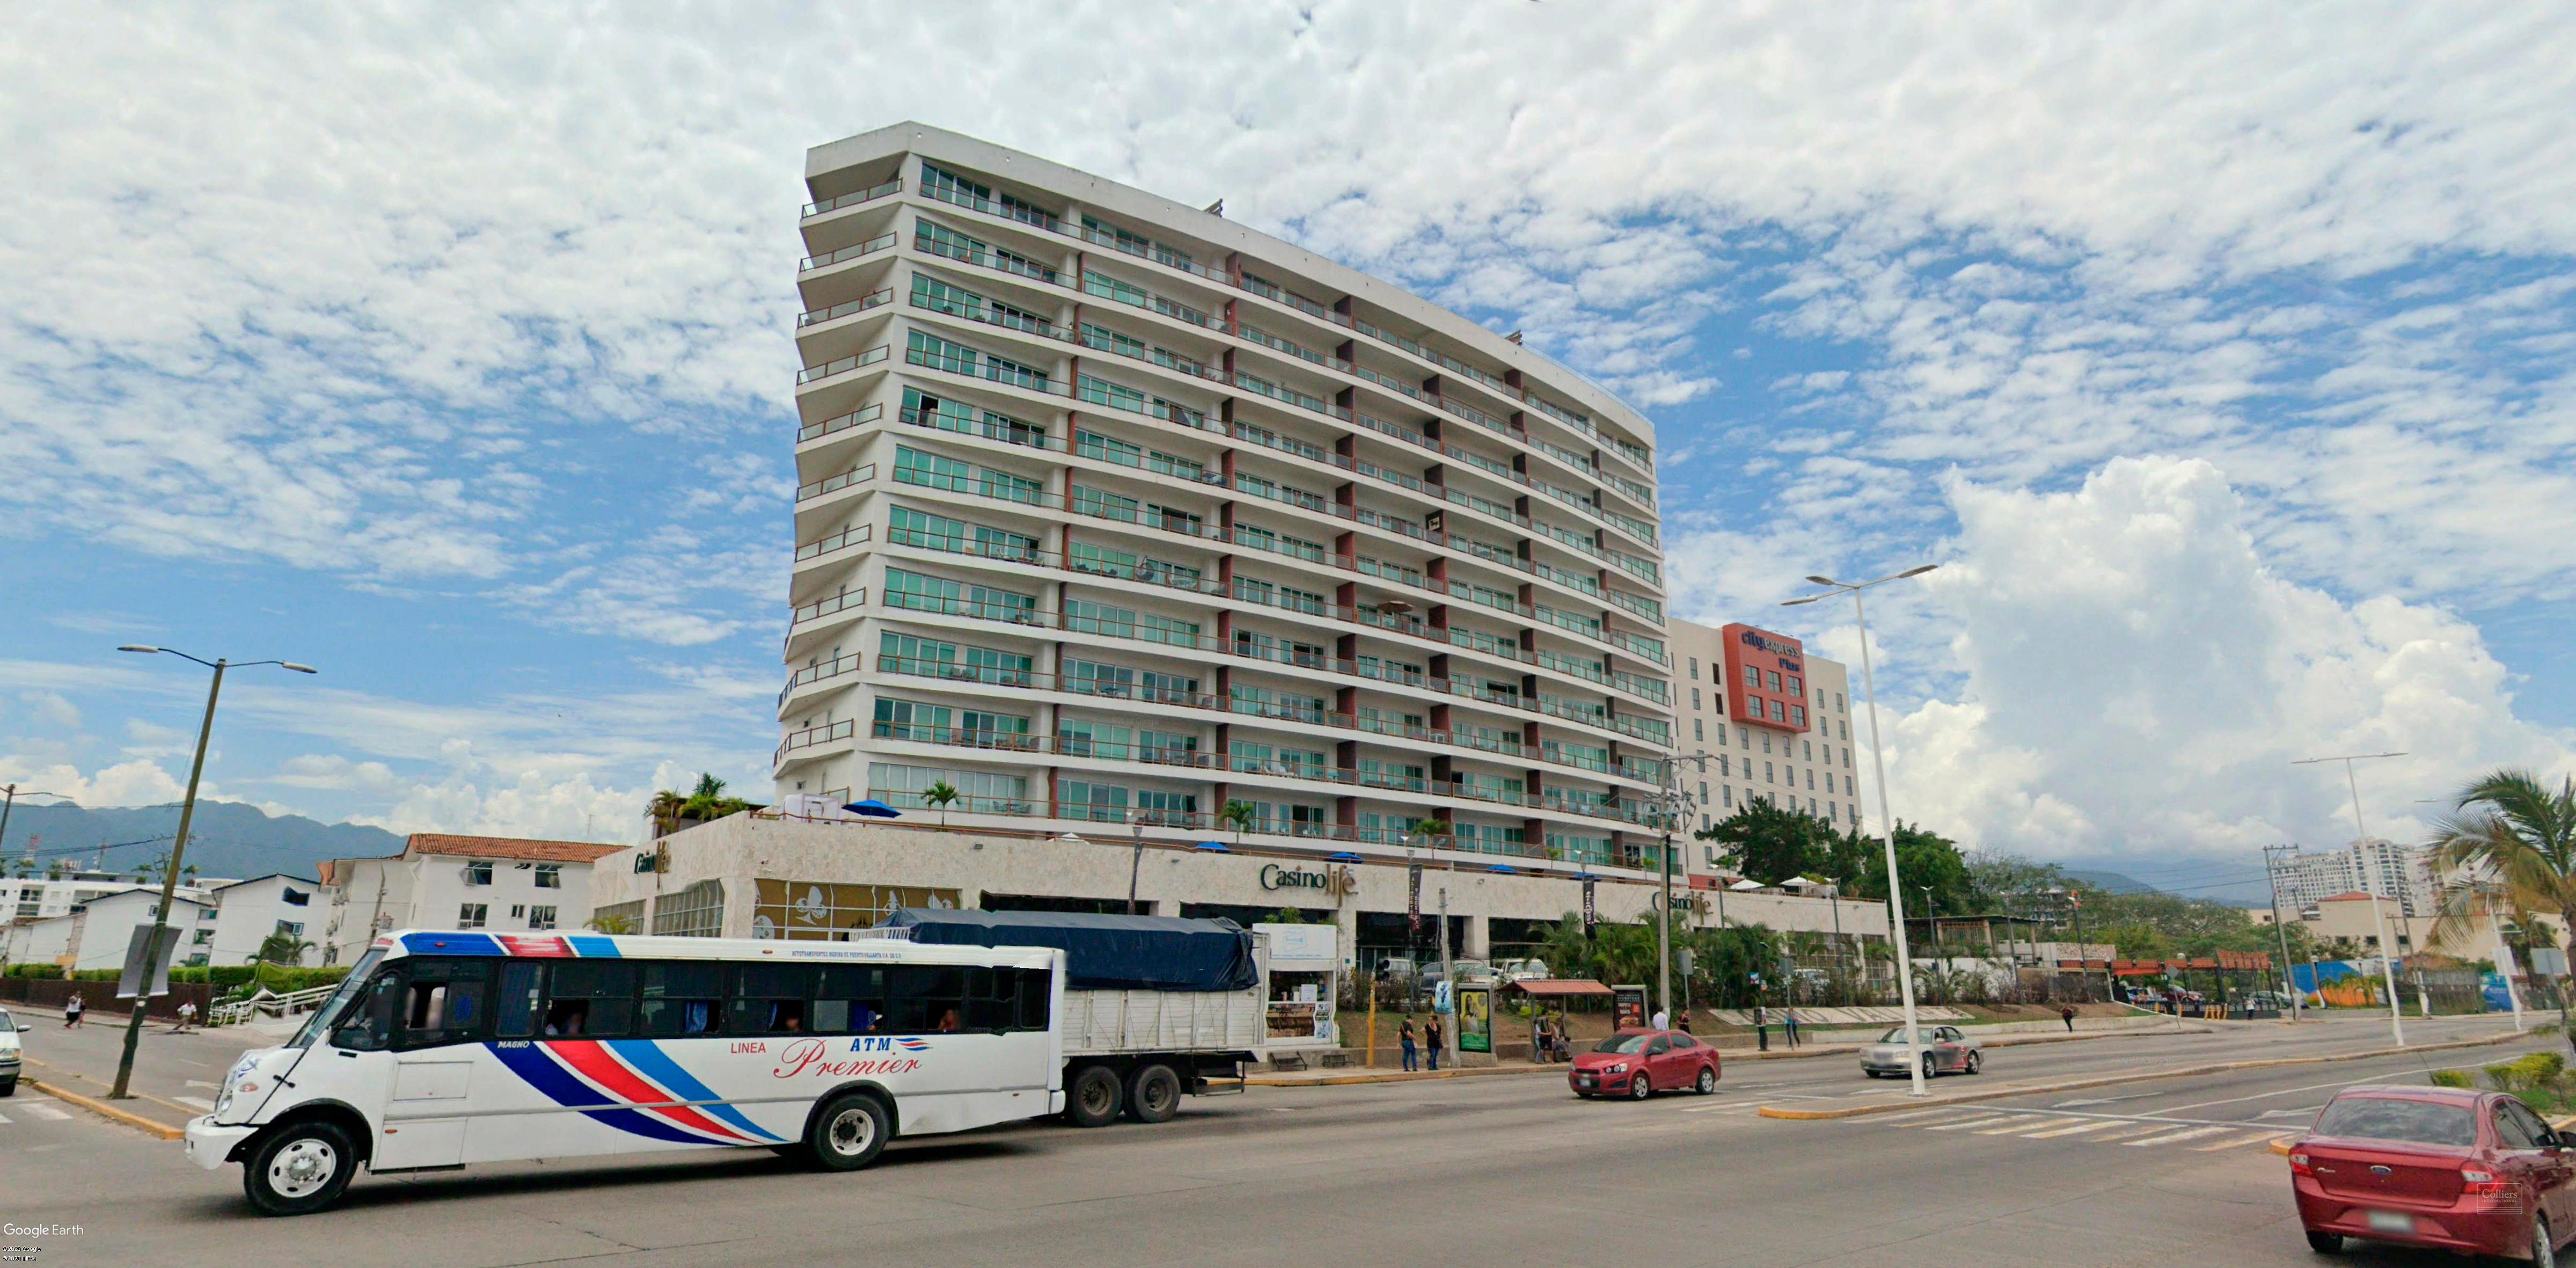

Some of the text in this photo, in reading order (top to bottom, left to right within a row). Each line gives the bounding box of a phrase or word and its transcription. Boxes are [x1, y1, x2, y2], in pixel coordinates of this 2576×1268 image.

[1779, 658, 1800, 672] Plus
[850, 1037, 891, 1052] ATM
[730, 1038, 922, 1078] LINEA Premier
